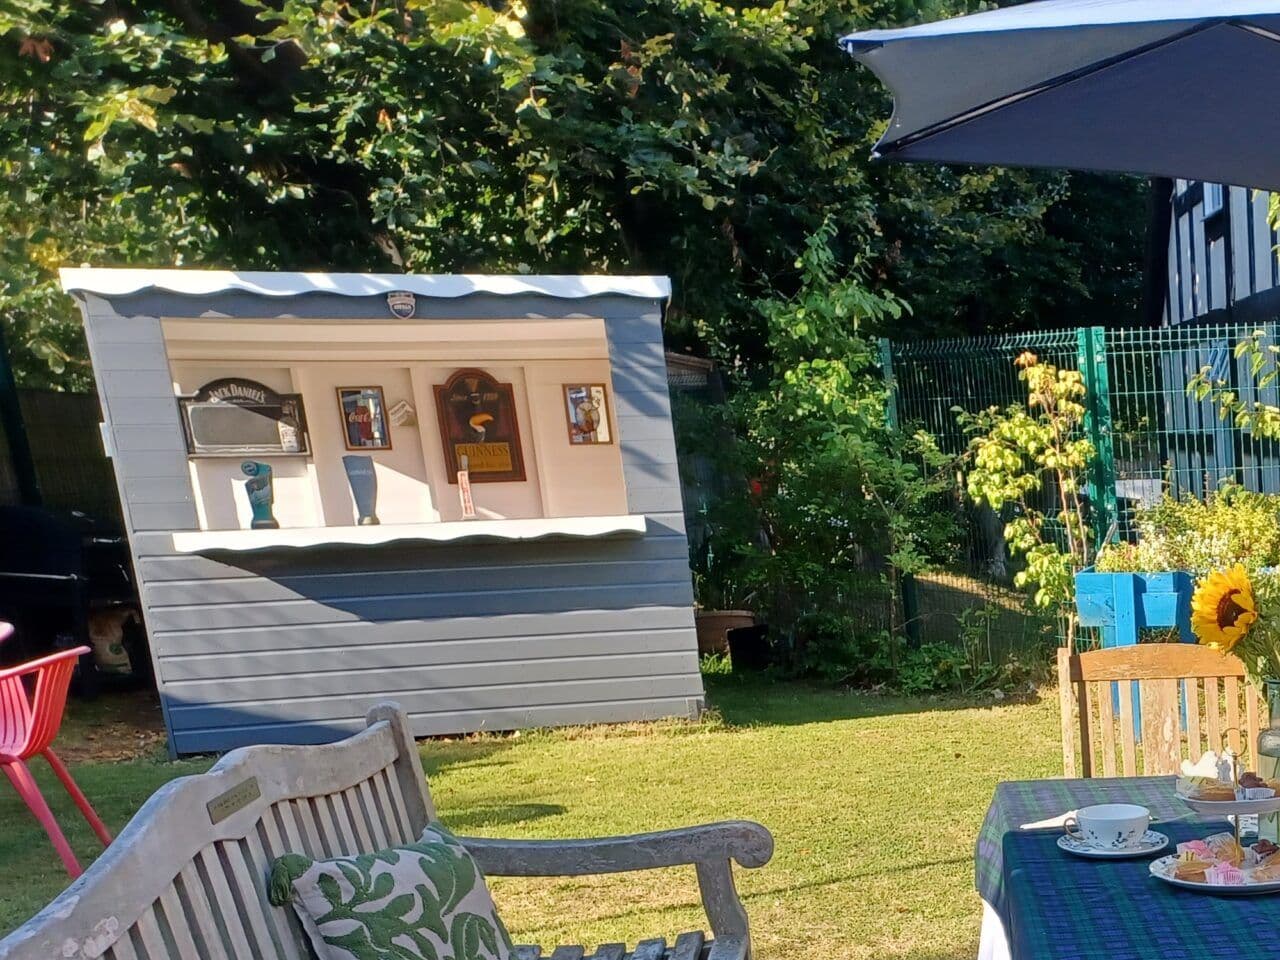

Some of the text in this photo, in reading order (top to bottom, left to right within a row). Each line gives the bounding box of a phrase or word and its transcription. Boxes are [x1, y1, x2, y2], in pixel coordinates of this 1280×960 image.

[208, 383, 265, 403] JACK DANIEL'S
[457, 444, 509, 456] GUINNESS
